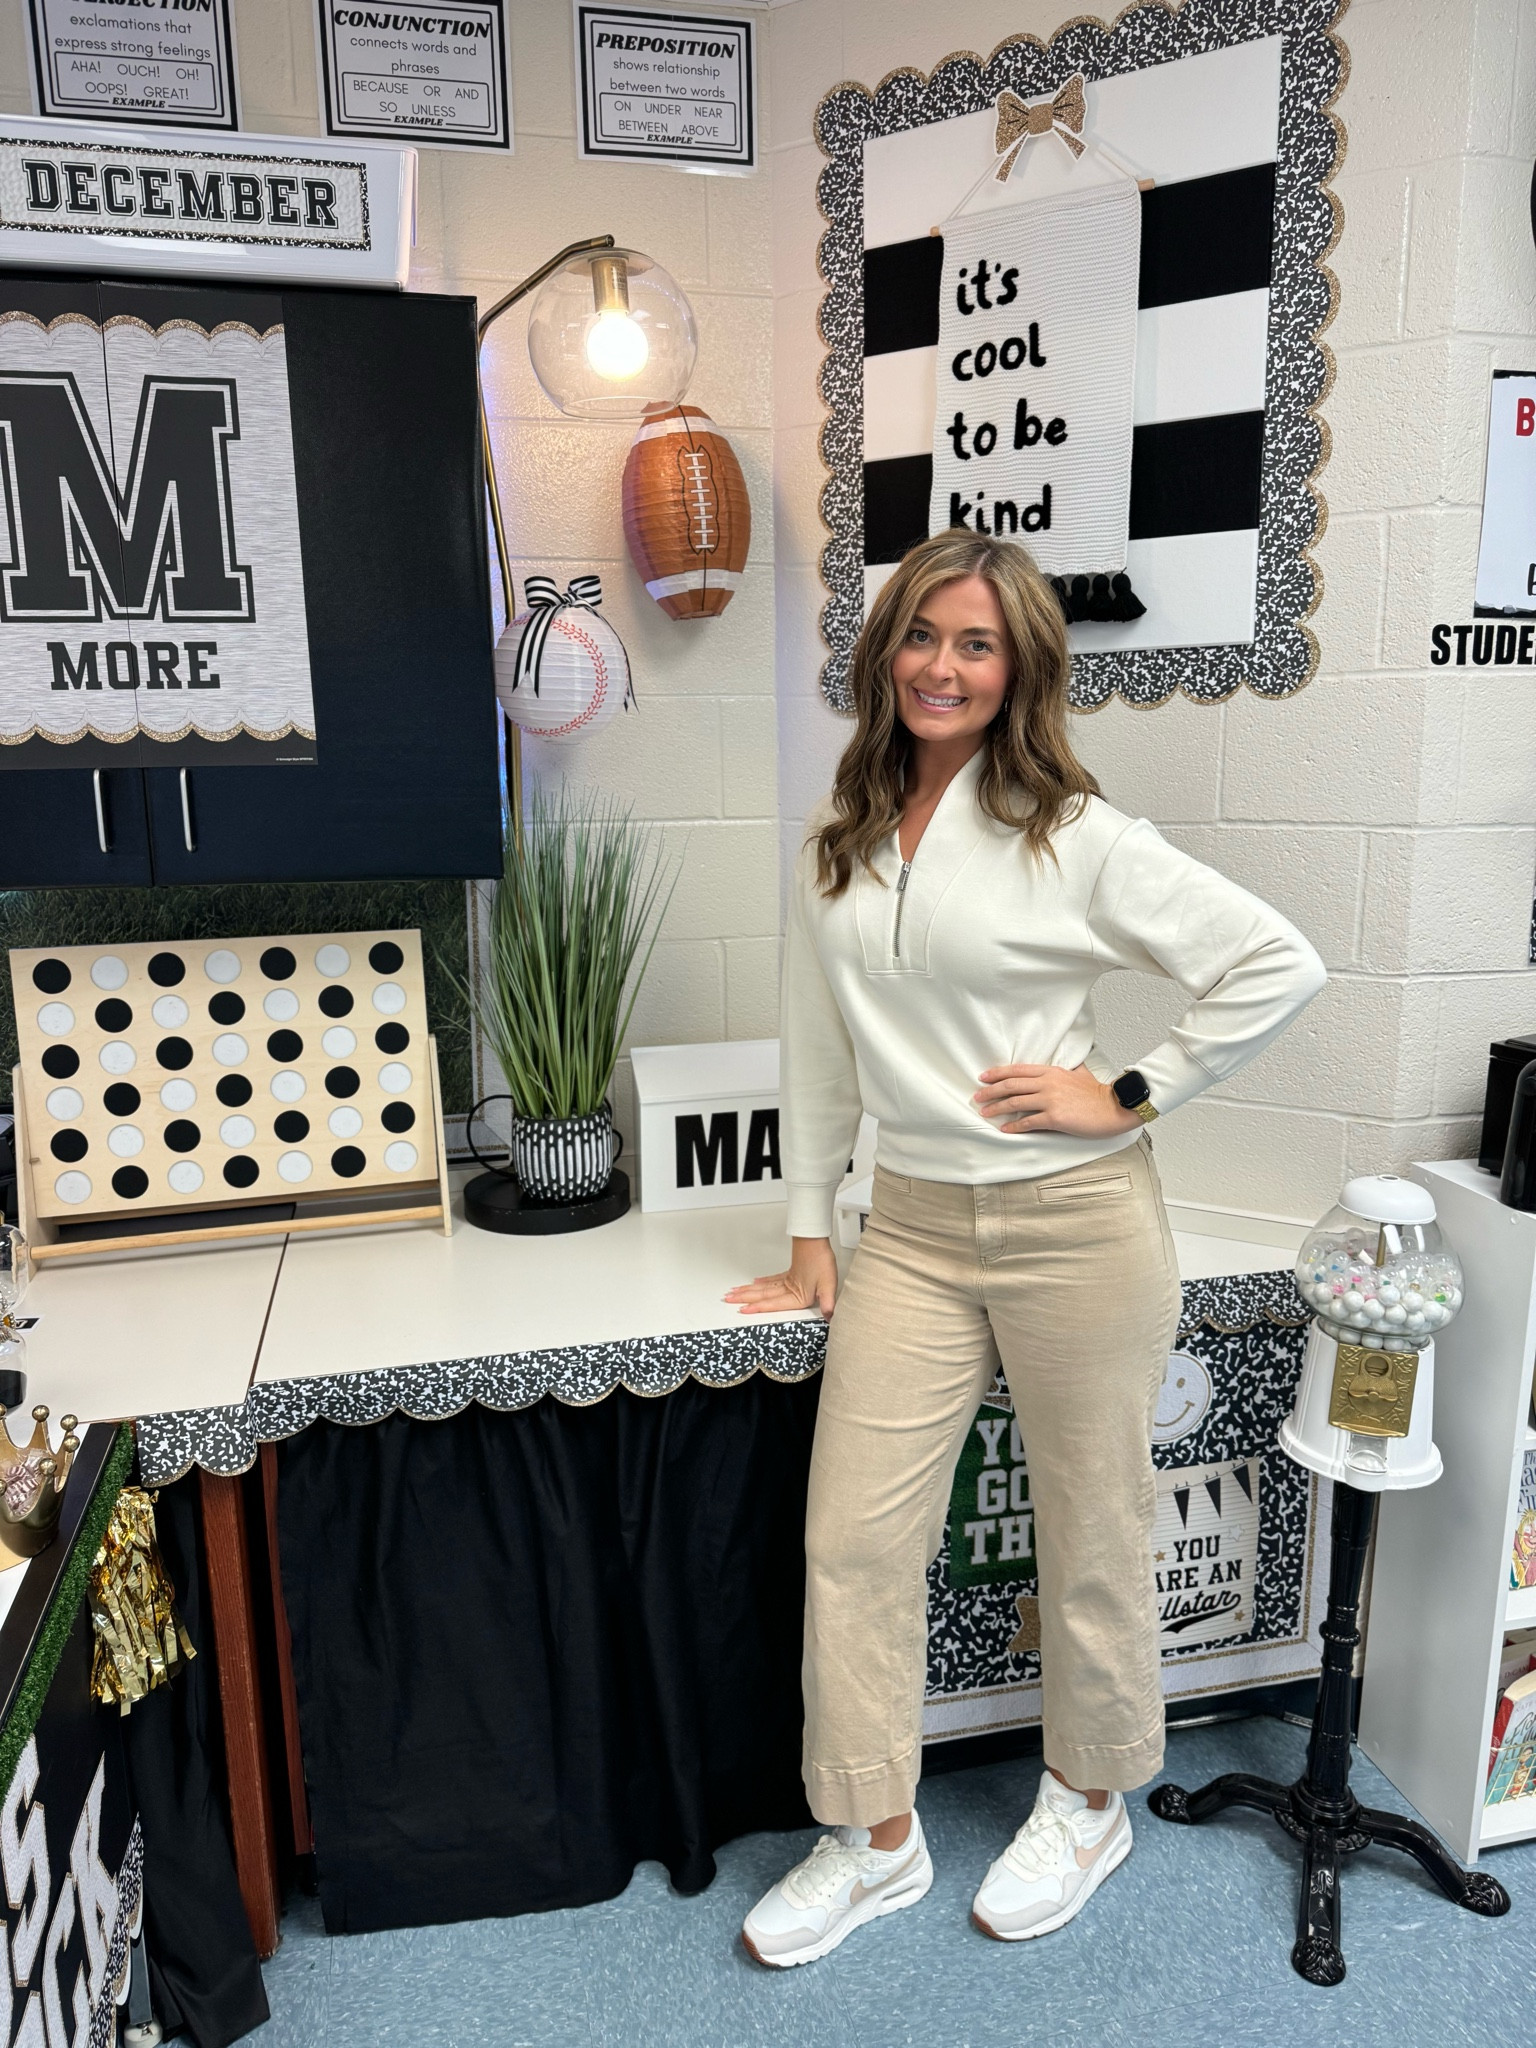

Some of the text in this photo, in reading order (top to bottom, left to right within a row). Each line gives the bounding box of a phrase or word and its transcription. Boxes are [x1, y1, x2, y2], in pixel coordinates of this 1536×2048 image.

[70, 14, 191, 34] exclamations that
[334, 10, 490, 38] CONJUNCTION
[55, 37, 211, 61] express strong feelings
[350, 37, 477, 56] connects words and
[596, 33, 736, 59] PREPOSITION
[70, 60, 199, 81] AHA! OUCH! OH!
[391, 59, 440, 75] phrases
[613, 57, 720, 80] shows relationship
[85, 82, 189, 100] OOPS! GREAT!
[353, 80, 479, 100] BECAUSE OR AND
[610, 77, 725, 98] between two words
[112, 97, 165, 108] EXAMPLE
[380, 102, 456, 118] SO UNLESS
[614, 101, 723, 118] ON UNDER NEAR
[394, 115, 443, 126] EXAMPLE
[619, 120, 719, 137] BETWEEN ABOVE
[647, 134, 693, 144] EXAMPLE
[21, 158, 340, 229] DECEMBER
[956, 259, 1019, 315] it's
[951, 322, 1046, 381] cool
[946, 398, 1068, 461] to be
[0, 370, 256, 624] M
[949, 483, 1052, 537] kind
[47, 641, 221, 690] MORE
[1174, 1535, 1221, 1562] YOU
[1208, 1559, 1242, 1585] AN
[1158, 1590, 1242, 1622] llstar
